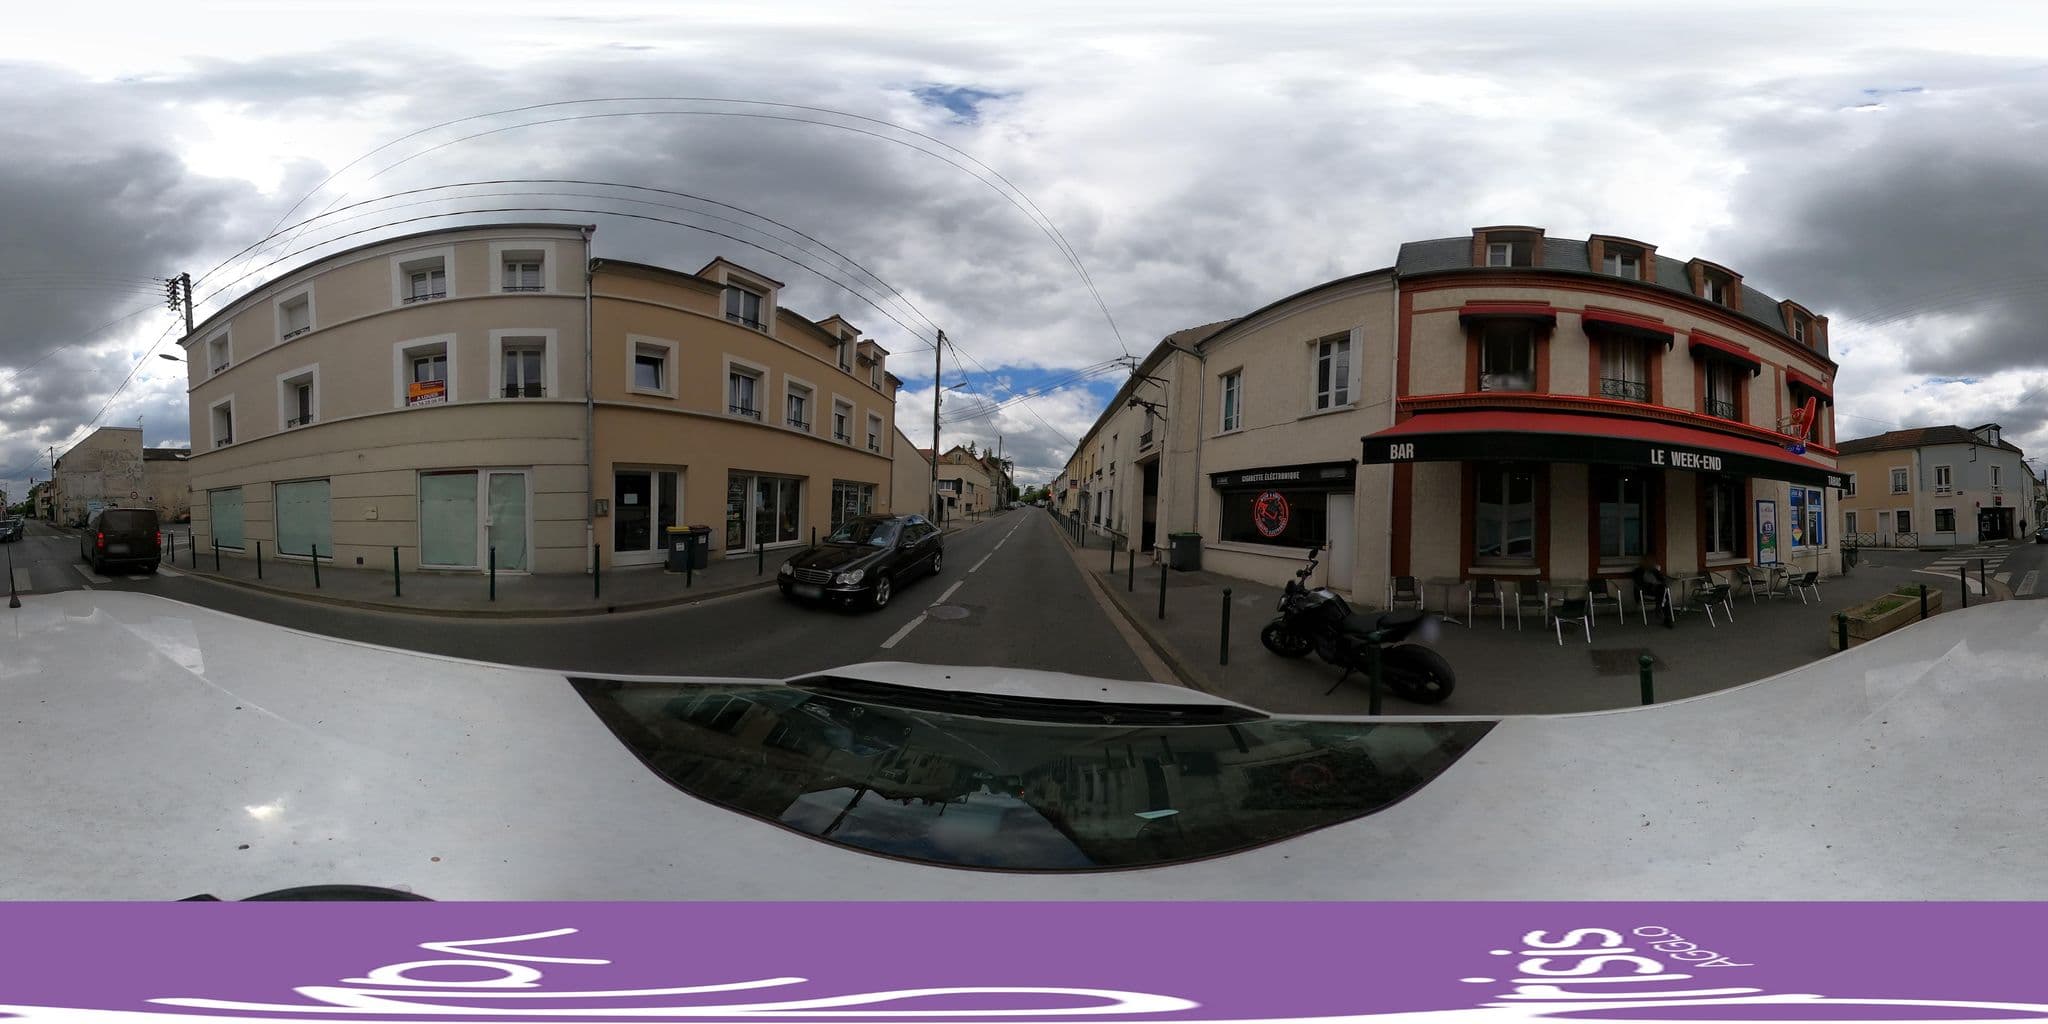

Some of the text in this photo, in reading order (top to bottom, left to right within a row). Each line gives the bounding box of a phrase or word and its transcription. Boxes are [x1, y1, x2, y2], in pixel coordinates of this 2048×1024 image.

[1390, 443, 1414, 460] BAR
[1651, 449, 1722, 472] LE WEEK-END
